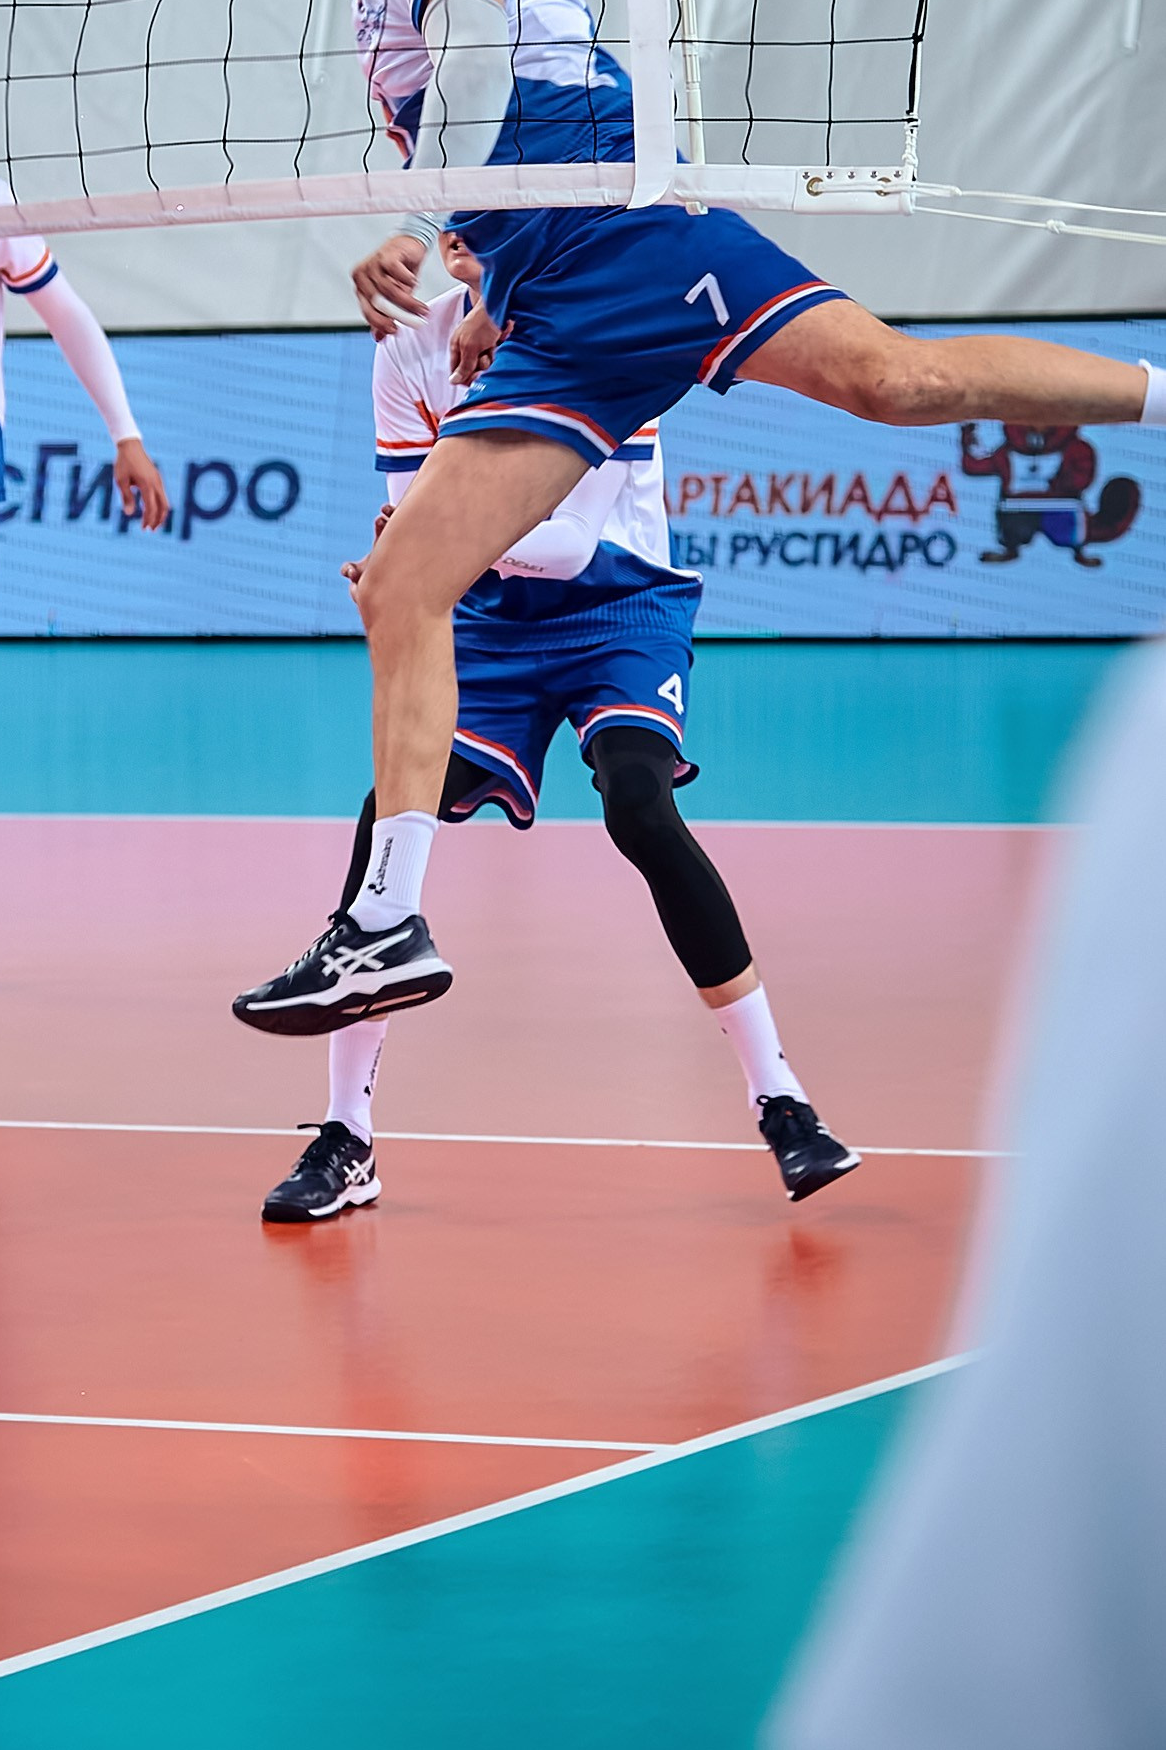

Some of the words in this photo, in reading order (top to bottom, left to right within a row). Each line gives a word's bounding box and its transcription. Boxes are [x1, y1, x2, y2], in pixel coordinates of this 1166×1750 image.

[683, 272, 731, 327] 7
[663, 473, 957, 523] РТАКИАДА
[656, 672, 685, 716] 4
